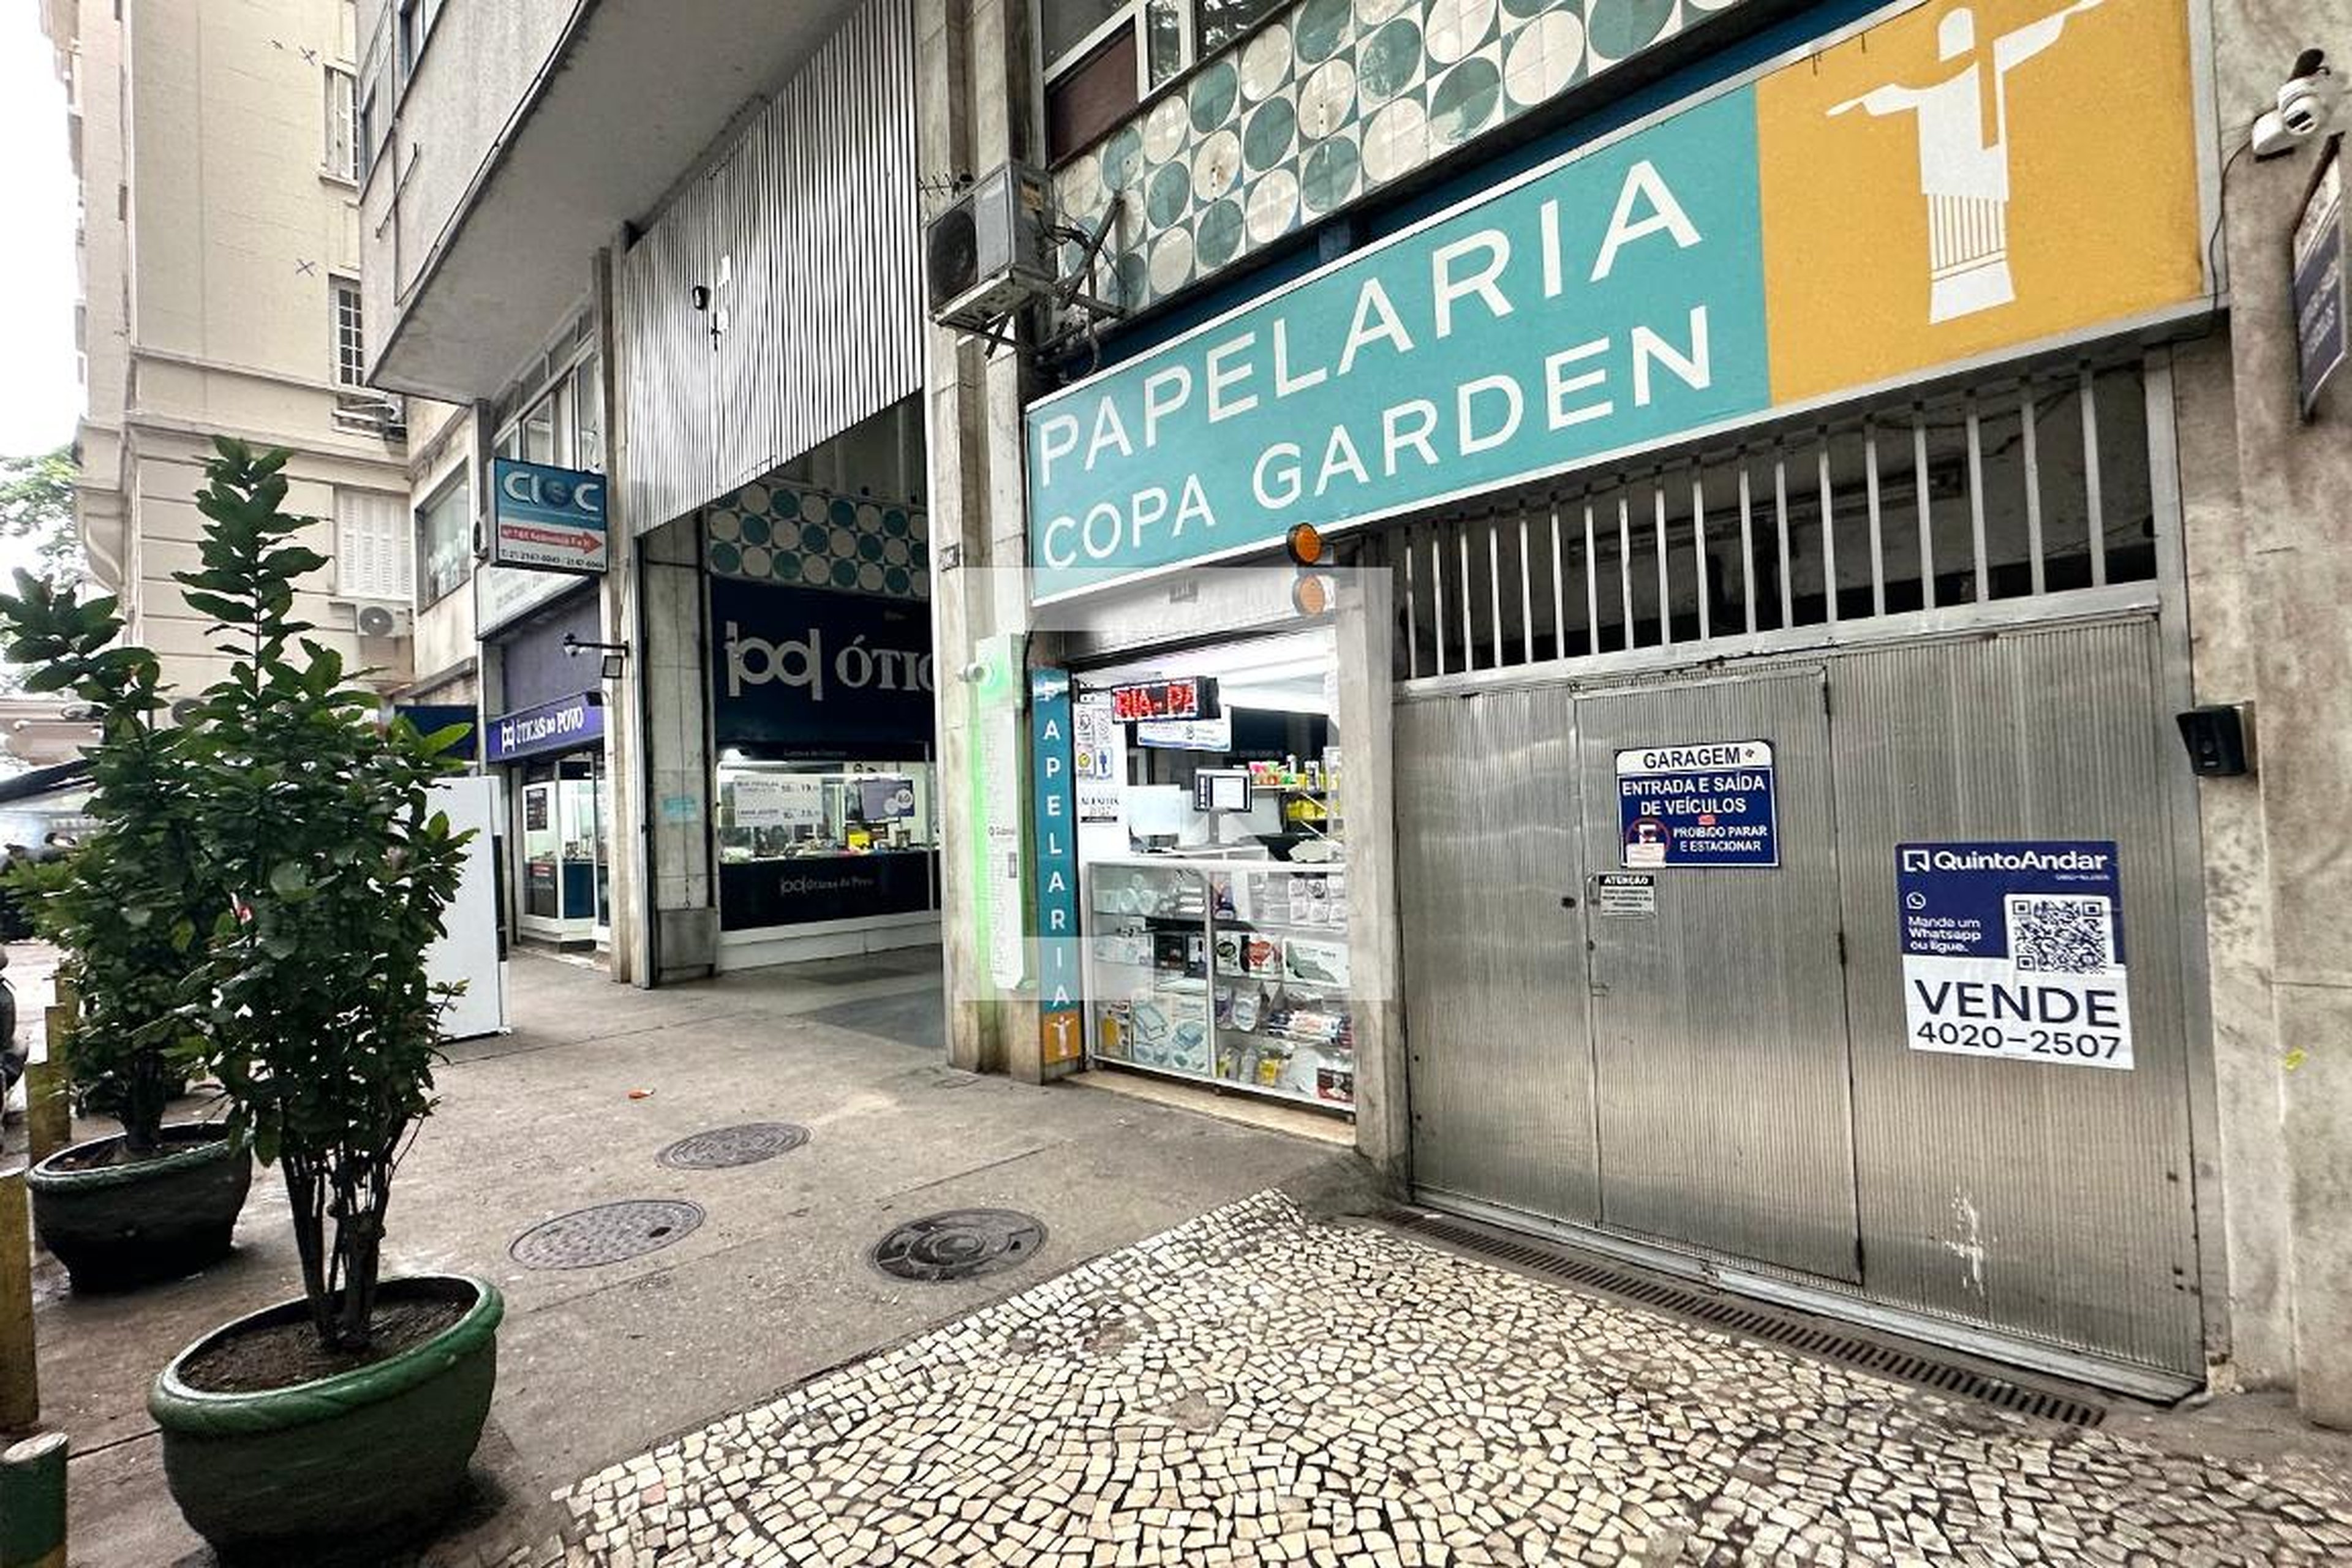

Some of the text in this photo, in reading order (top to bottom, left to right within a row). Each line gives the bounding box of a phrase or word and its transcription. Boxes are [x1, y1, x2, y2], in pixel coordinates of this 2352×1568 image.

[1039, 160, 1702, 488] PAPELARIA
[1042, 306, 1710, 570] COPA GARDEN
[1643, 747, 1741, 769] GARAGEM
[1622, 772, 1765, 796] ENTRADA E SAÍDA
[1641, 796, 1746, 815] DE VEÍCULOS
[1673, 825, 1768, 838] PROIBIDO PARAR
[1042, 681, 1070, 1007] APELARIA
[1680, 840, 1762, 852] E ESTACIONAR
[1934, 850, 2108, 871] QuintoAndar
[1909, 916, 1981, 928] Mande um
[1909, 929, 1981, 941] Whatsapp
[1910, 940, 1969, 954] ou ligue.
[1915, 979, 2121, 1029] VENDE
[1917, 1022, 2122, 1059] 4020-2507
